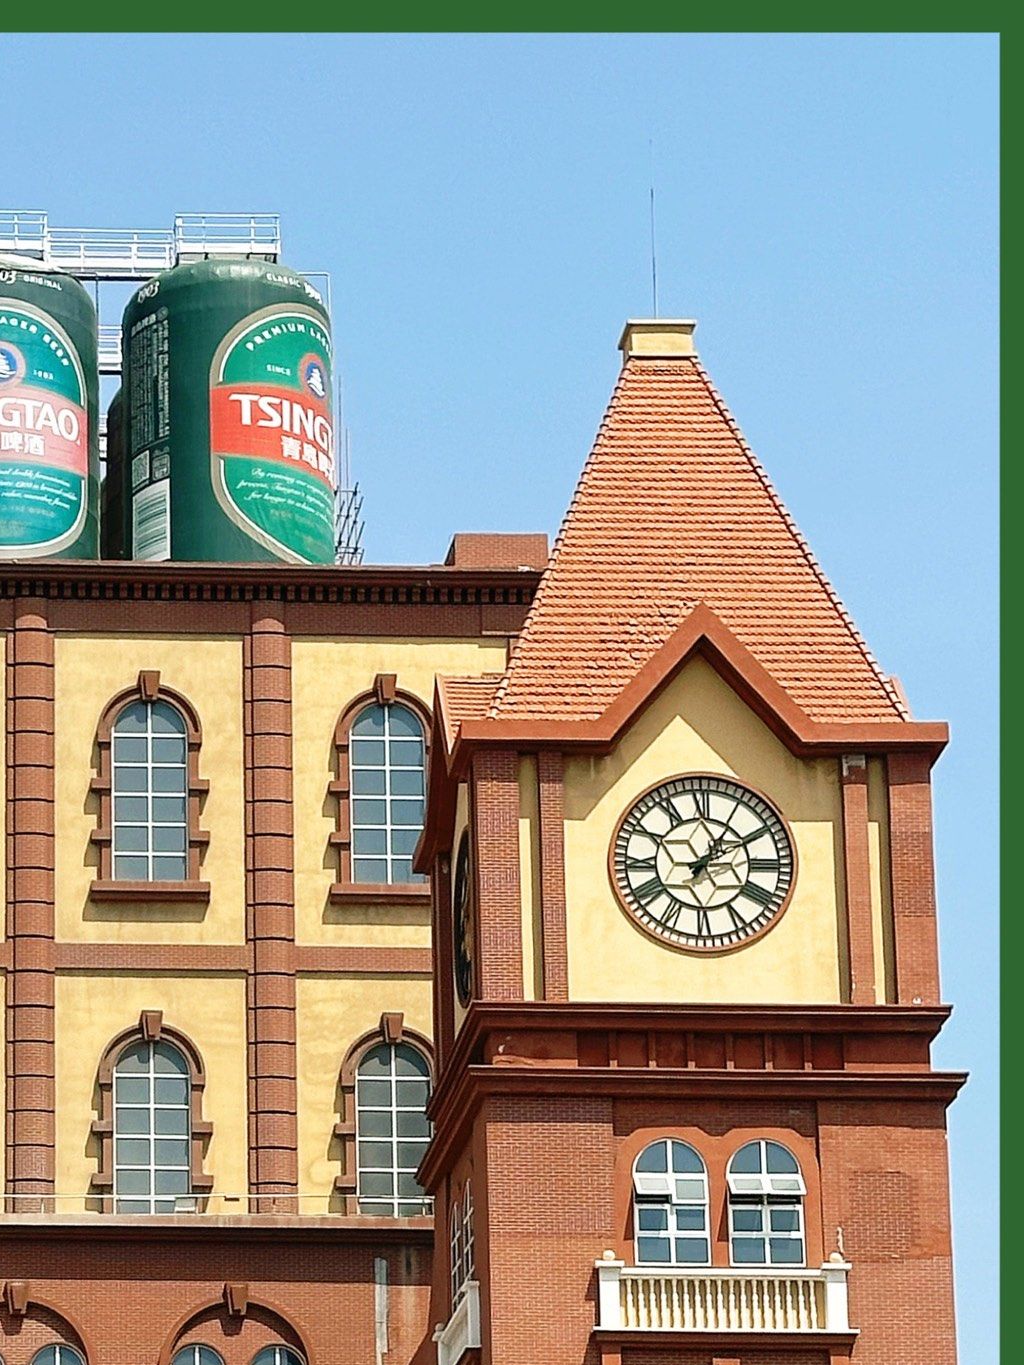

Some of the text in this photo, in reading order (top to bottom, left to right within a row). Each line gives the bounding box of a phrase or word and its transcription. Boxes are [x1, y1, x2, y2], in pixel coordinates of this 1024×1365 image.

[23, 275, 62, 291] ORIGINAL
[266, 273, 301, 288] CLASSIC
[245, 323, 305, 351] PREMIUM
[43, 334, 69, 366] BEER
[266, 364, 291, 376] SINCE
